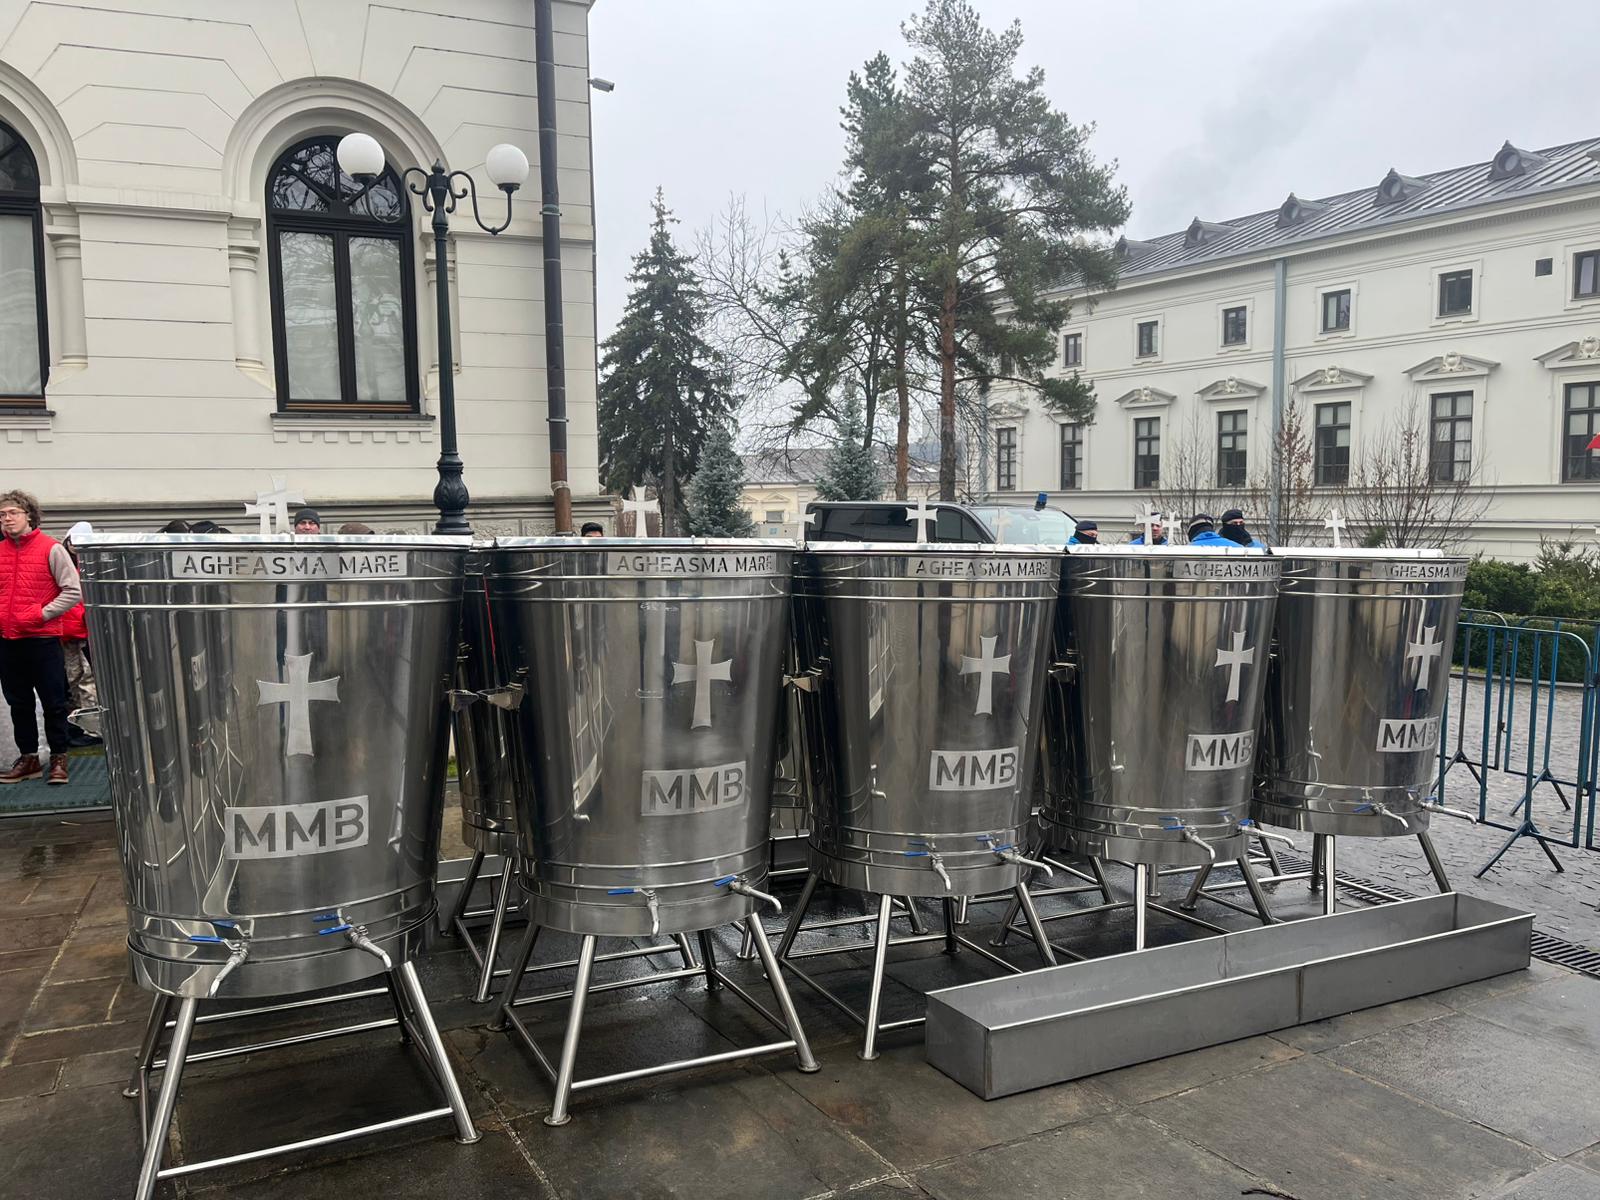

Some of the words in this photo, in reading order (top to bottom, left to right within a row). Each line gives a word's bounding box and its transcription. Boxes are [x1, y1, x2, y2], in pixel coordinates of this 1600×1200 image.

[183, 555, 328, 575] AGHEASMA
[339, 555, 400, 574] MARE
[616, 555, 728, 573] AGHEASMA
[735, 554, 773, 573] MARE
[916, 560, 1011, 577] AGHEASMA
[1182, 562, 1259, 577] AGHEASMA
[1382, 721, 1437, 748] MMB
[1191, 736, 1252, 766] MMB
[936, 753, 1016, 786] MMB
[649, 768, 743, 810] MMB
[234, 804, 364, 853] MMB
